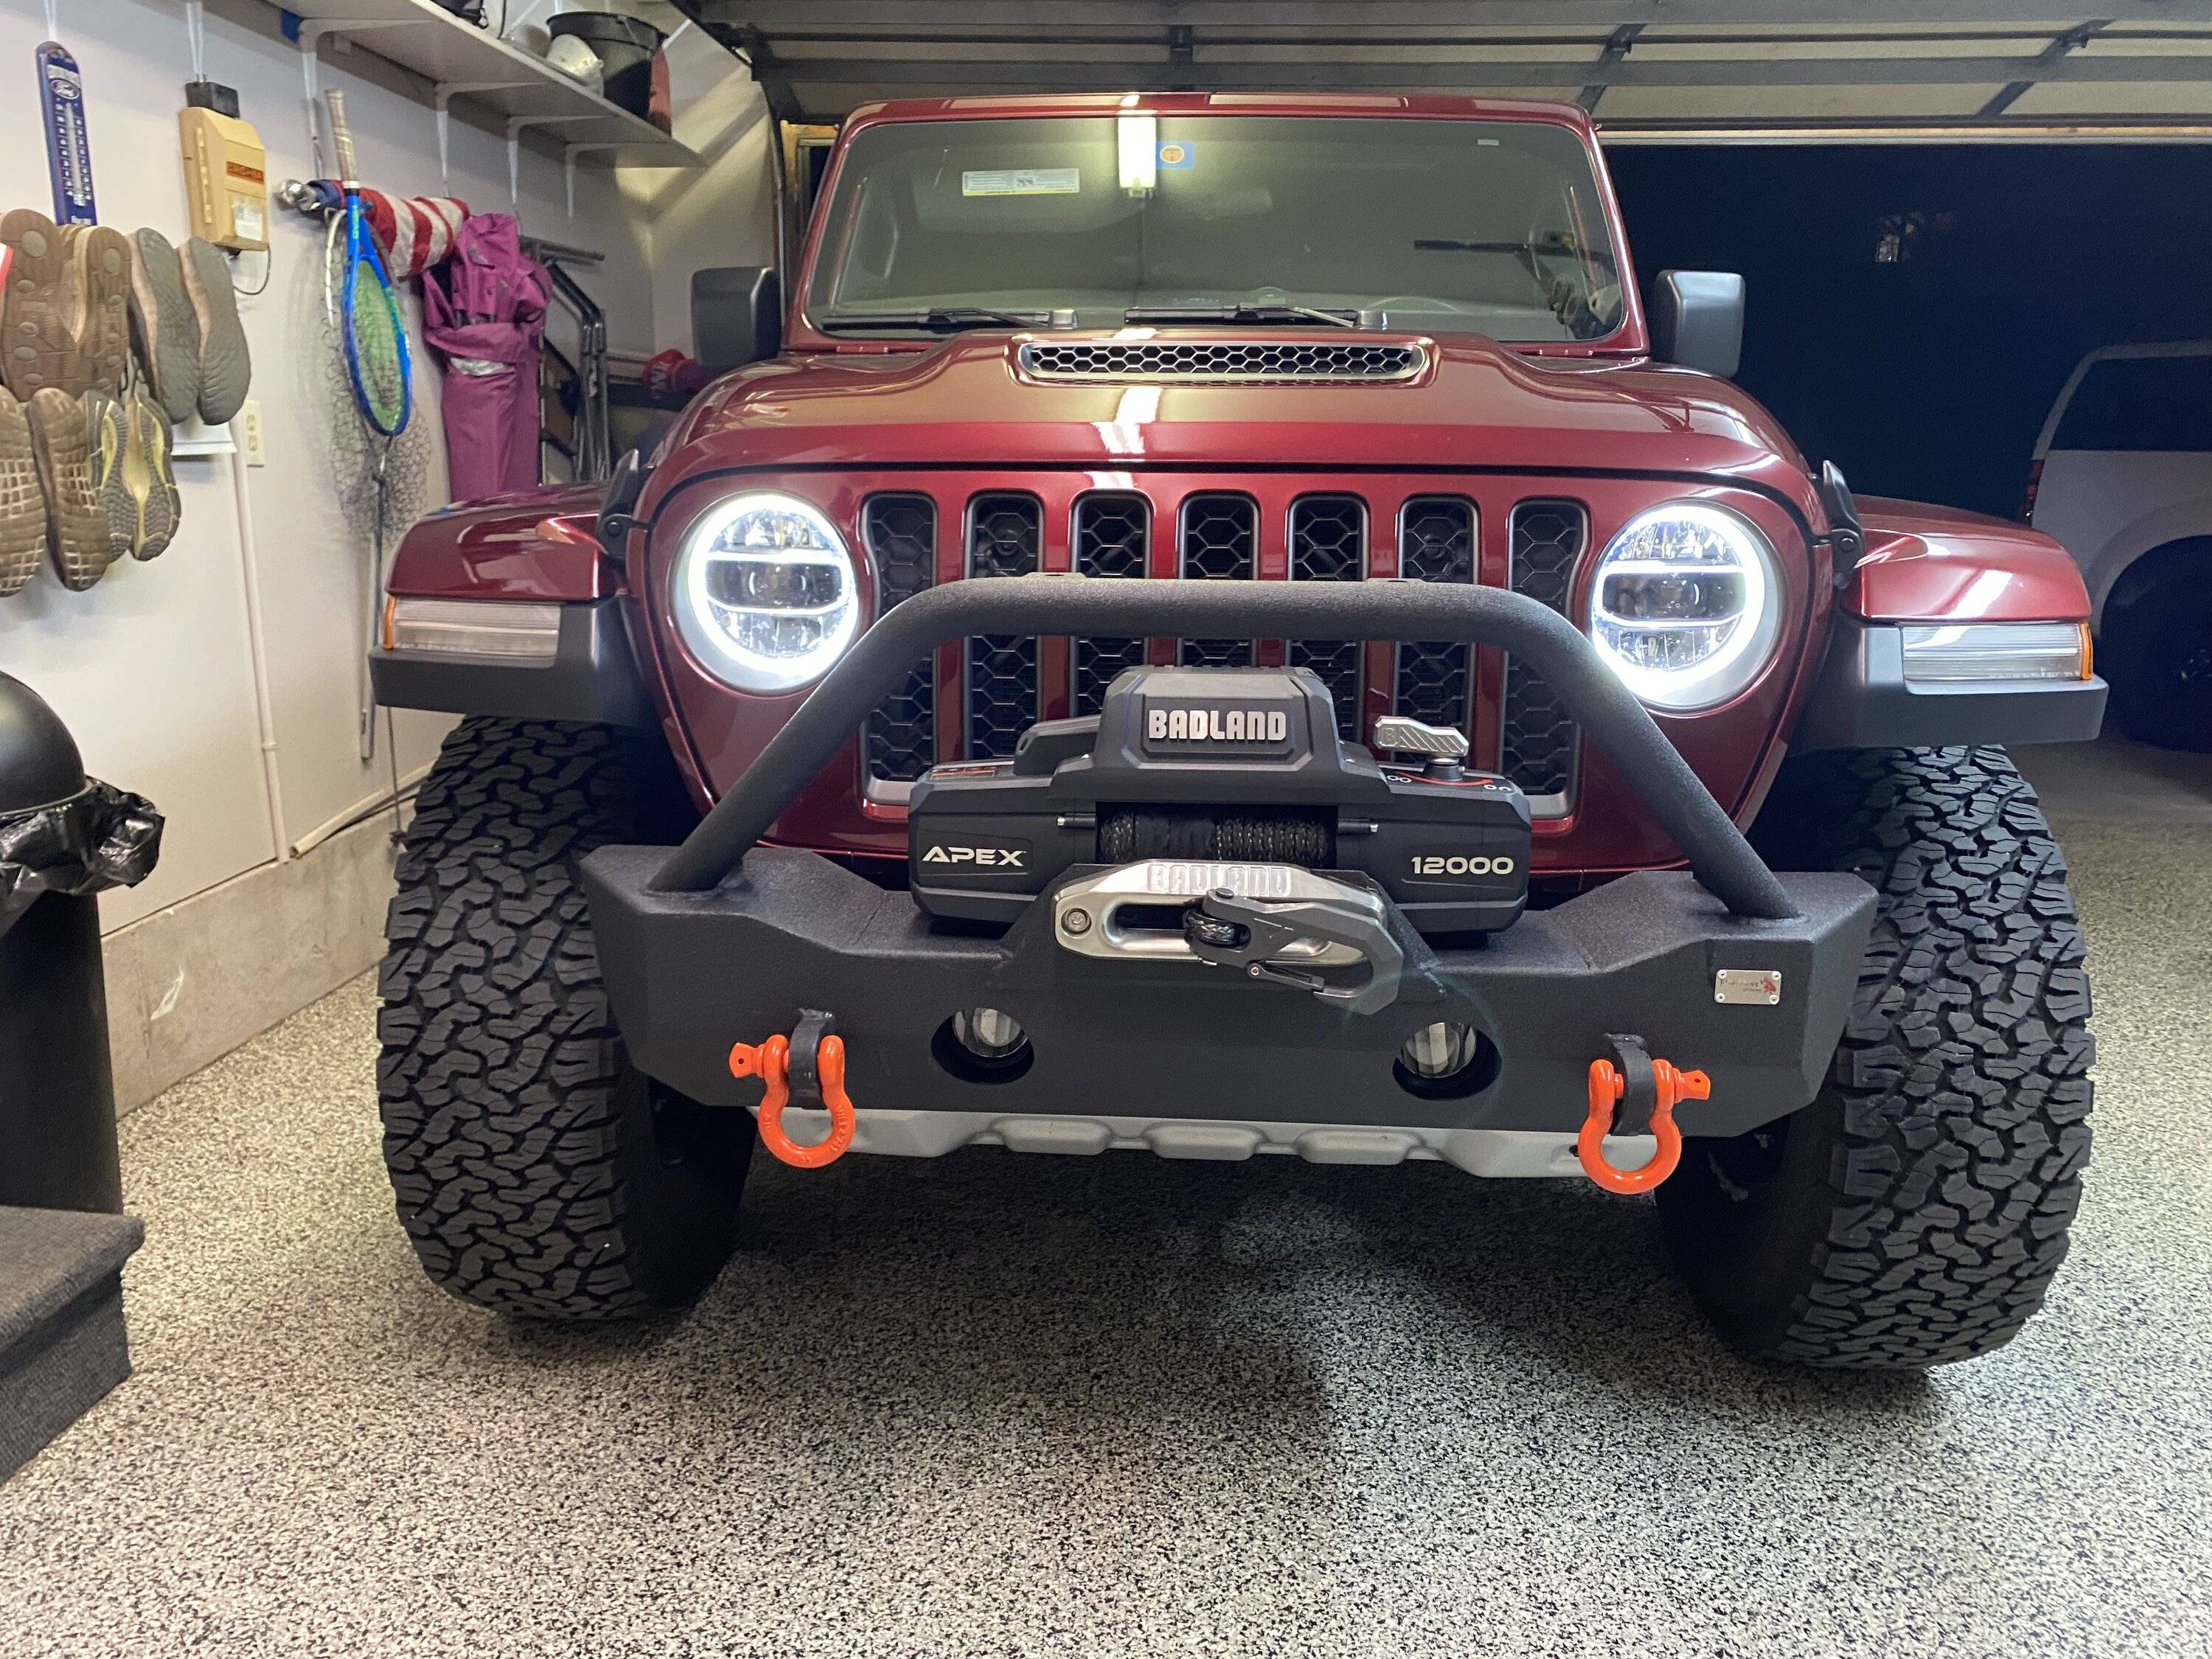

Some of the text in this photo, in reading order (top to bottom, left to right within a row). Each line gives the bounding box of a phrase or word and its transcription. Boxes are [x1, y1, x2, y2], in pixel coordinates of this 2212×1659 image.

[1149, 709, 1287, 740] BADLAND
[922, 846, 1023, 867] APEX
[1411, 856, 1514, 875] 12000
